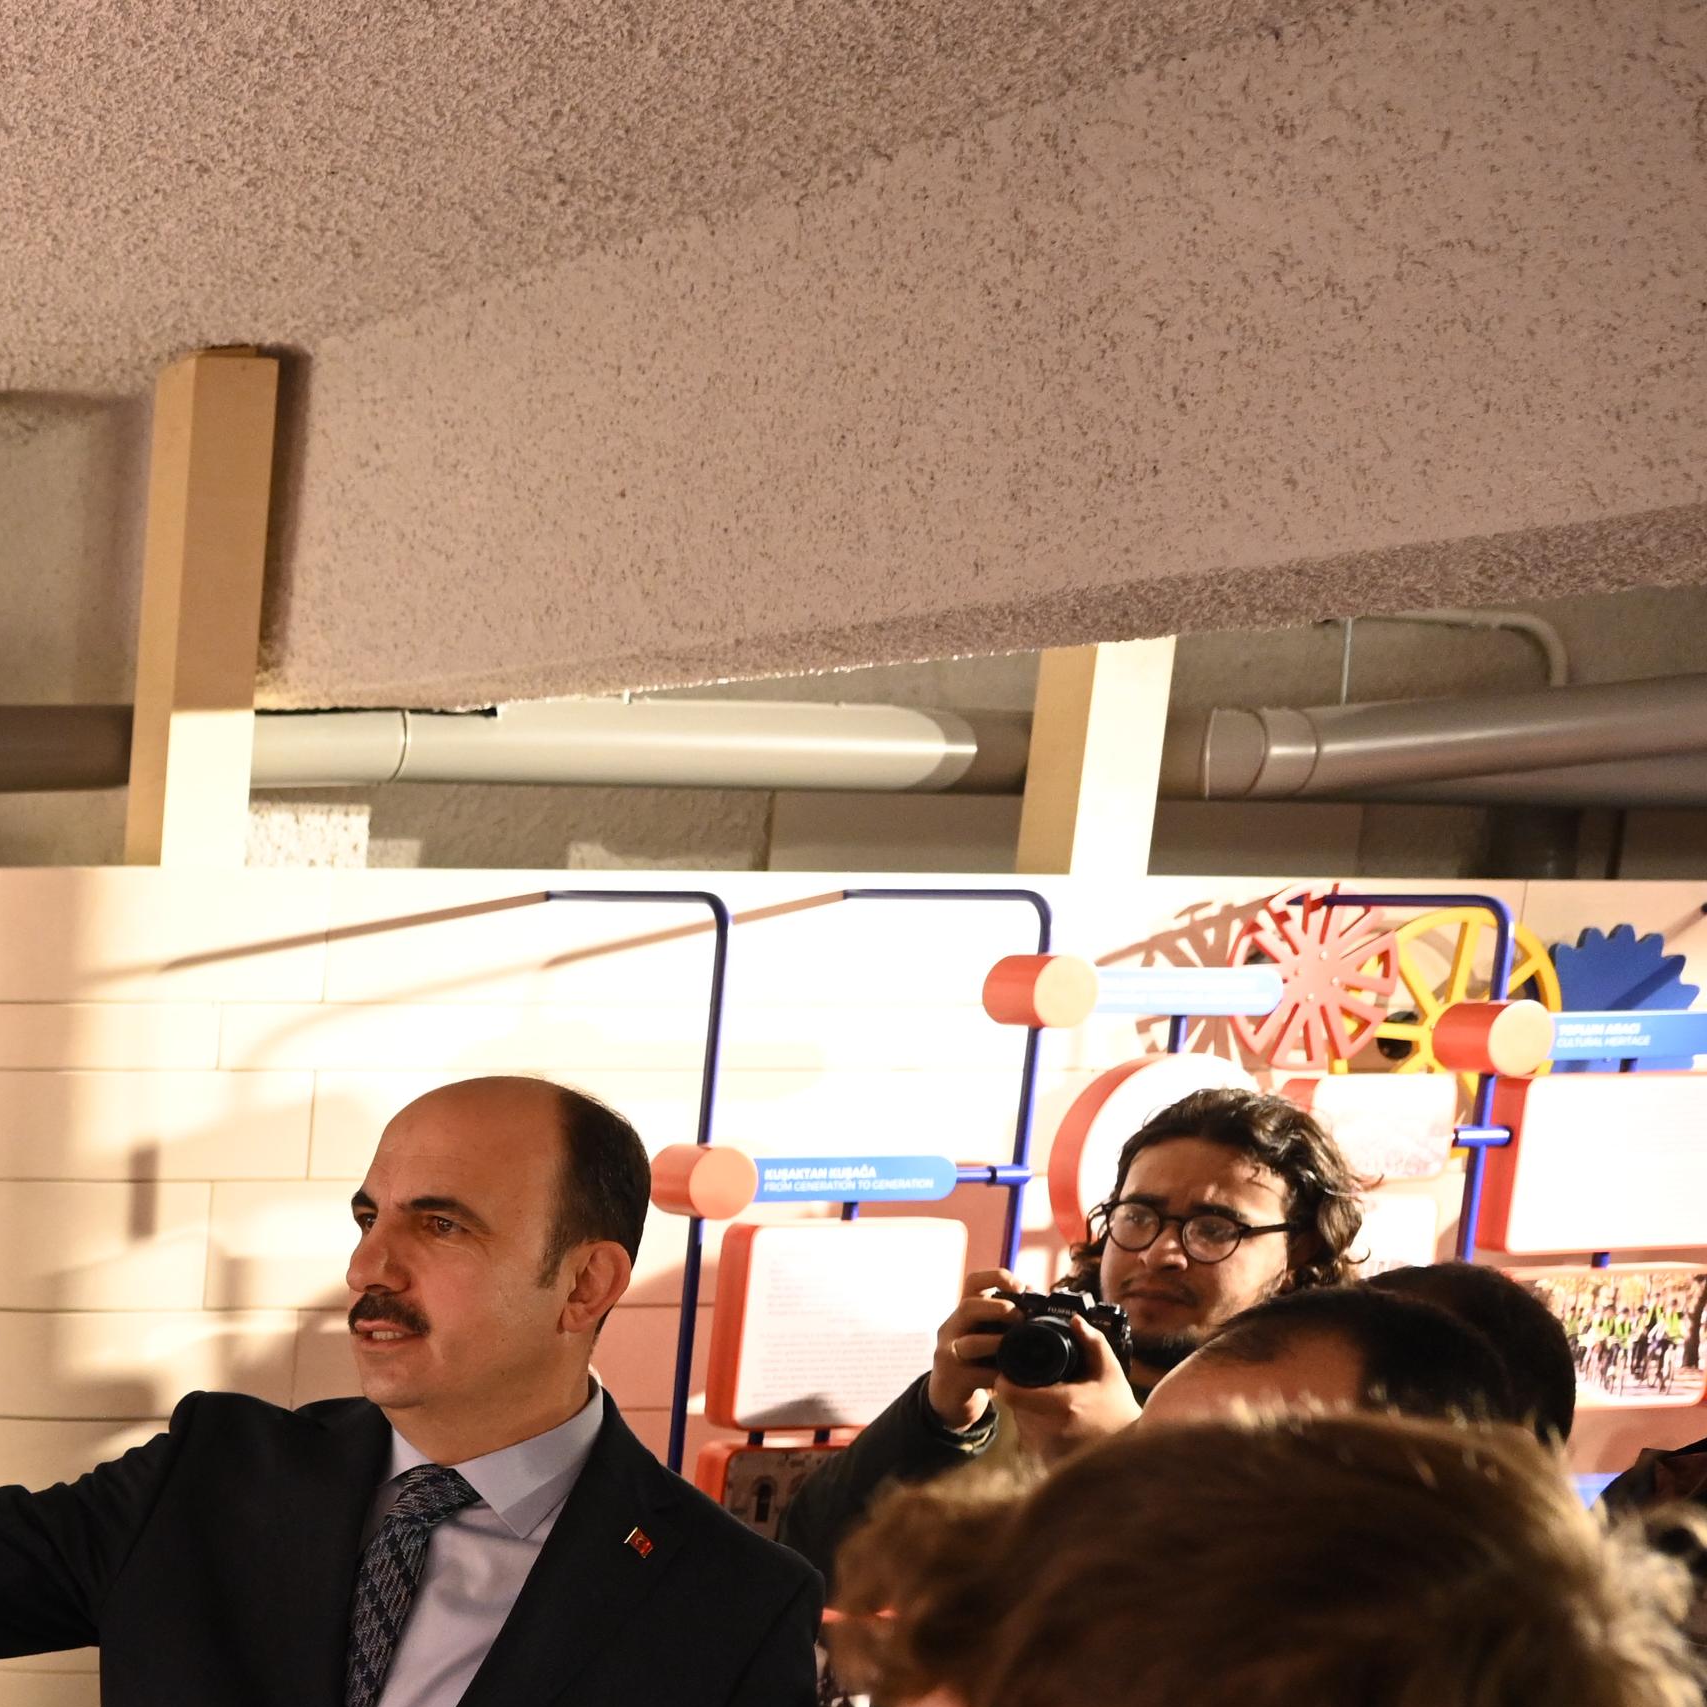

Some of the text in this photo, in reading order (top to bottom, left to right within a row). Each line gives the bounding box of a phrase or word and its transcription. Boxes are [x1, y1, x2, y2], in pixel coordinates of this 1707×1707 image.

[1556, 1034, 1651, 1048] CULTURAL HERITAGE
[764, 1167, 828, 1181] KUŞAKTAN
[764, 1177, 935, 1192] FROM GENERATION TO GENERATION
